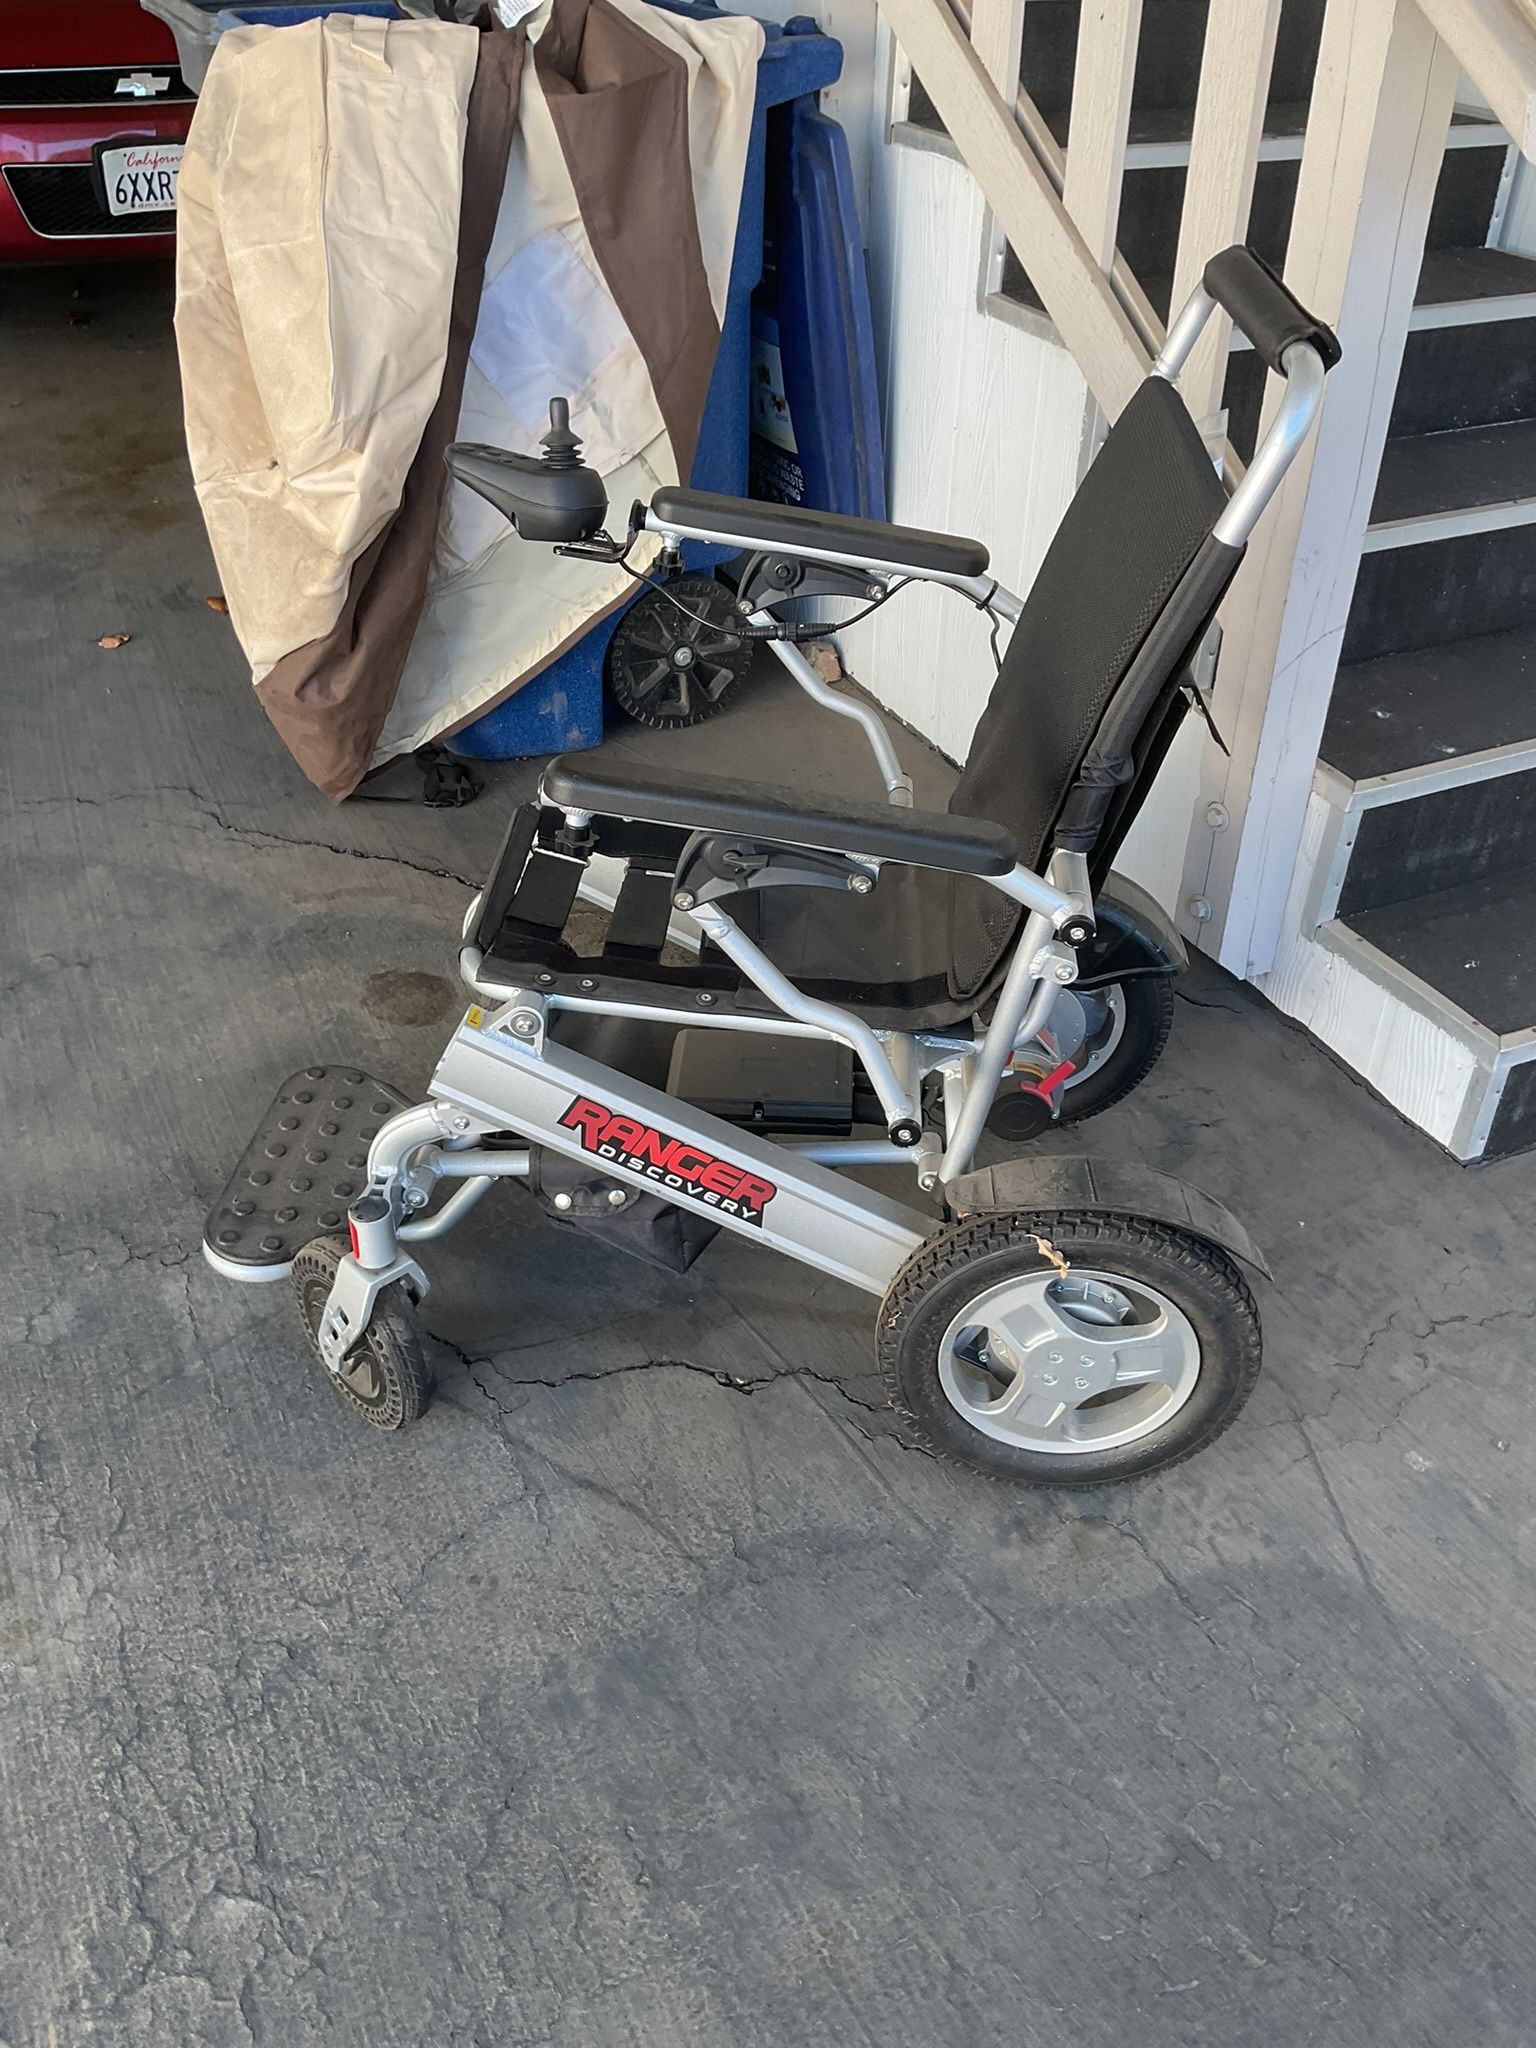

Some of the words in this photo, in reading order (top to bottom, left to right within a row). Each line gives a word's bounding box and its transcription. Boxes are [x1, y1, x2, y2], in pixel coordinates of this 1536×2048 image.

[116, 170, 179, 204] 6XXR
[561, 1096, 777, 1210] RANGER
[598, 1143, 757, 1219] DISCOVERY
